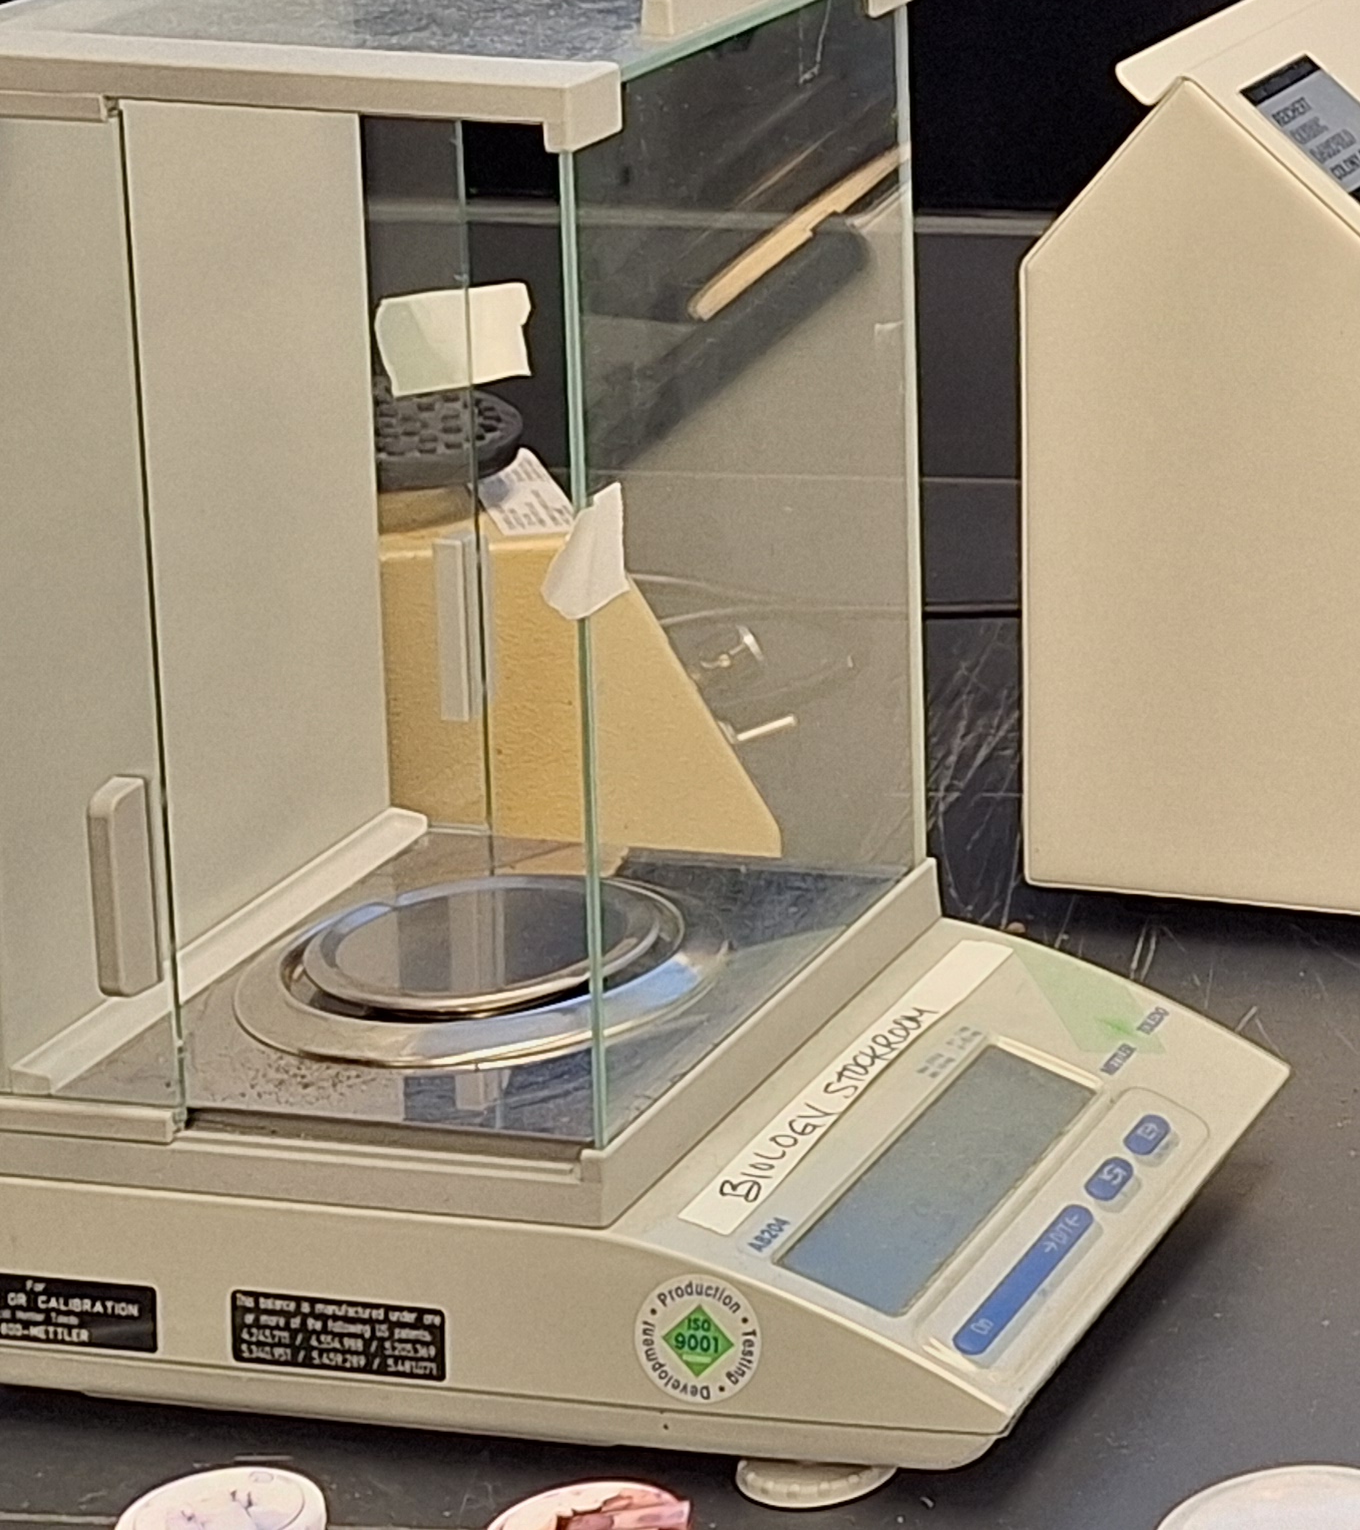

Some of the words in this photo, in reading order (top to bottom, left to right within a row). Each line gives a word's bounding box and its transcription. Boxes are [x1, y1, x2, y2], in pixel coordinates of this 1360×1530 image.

[719, 1103, 842, 1203] BIOLOGY
[824, 1007, 939, 1099] STOCKROOM
[748, 1216, 791, 1253] AB204
[37, 1295, 139, 1317] CALIBRATION
[657, 1281, 741, 1314] Production
[687, 1317, 711, 1332] ISO
[642, 1320, 711, 1400] Development
[674, 1332, 719, 1353] 9001
[726, 1329, 757, 1385] Testing
